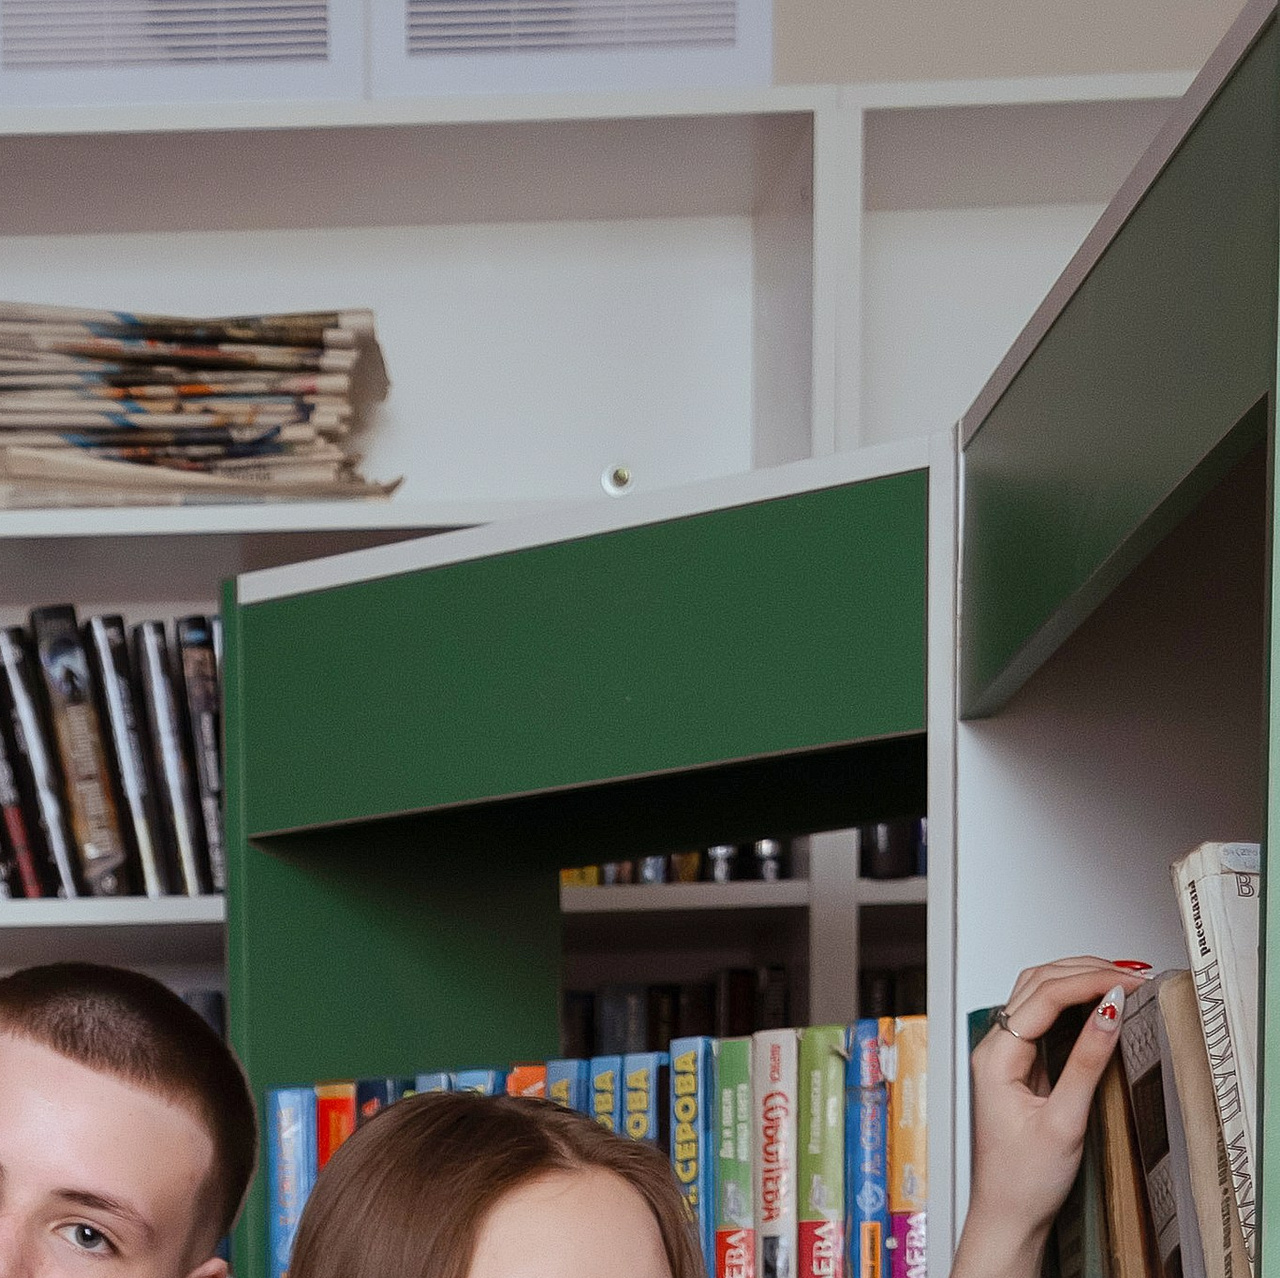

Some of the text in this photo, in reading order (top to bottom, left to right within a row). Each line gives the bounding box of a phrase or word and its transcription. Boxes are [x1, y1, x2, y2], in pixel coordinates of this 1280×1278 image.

[1188, 879, 1212, 957] рассказы
[1235, 872, 1259, 898] В
[593, 1069, 614, 1131] ОВА
[626, 1067, 649, 1141] ОВА
[674, 1050, 698, 1184] СЕРОВА
[1194, 958, 1257, 1264] ИЛИЙ ШУКШИН
